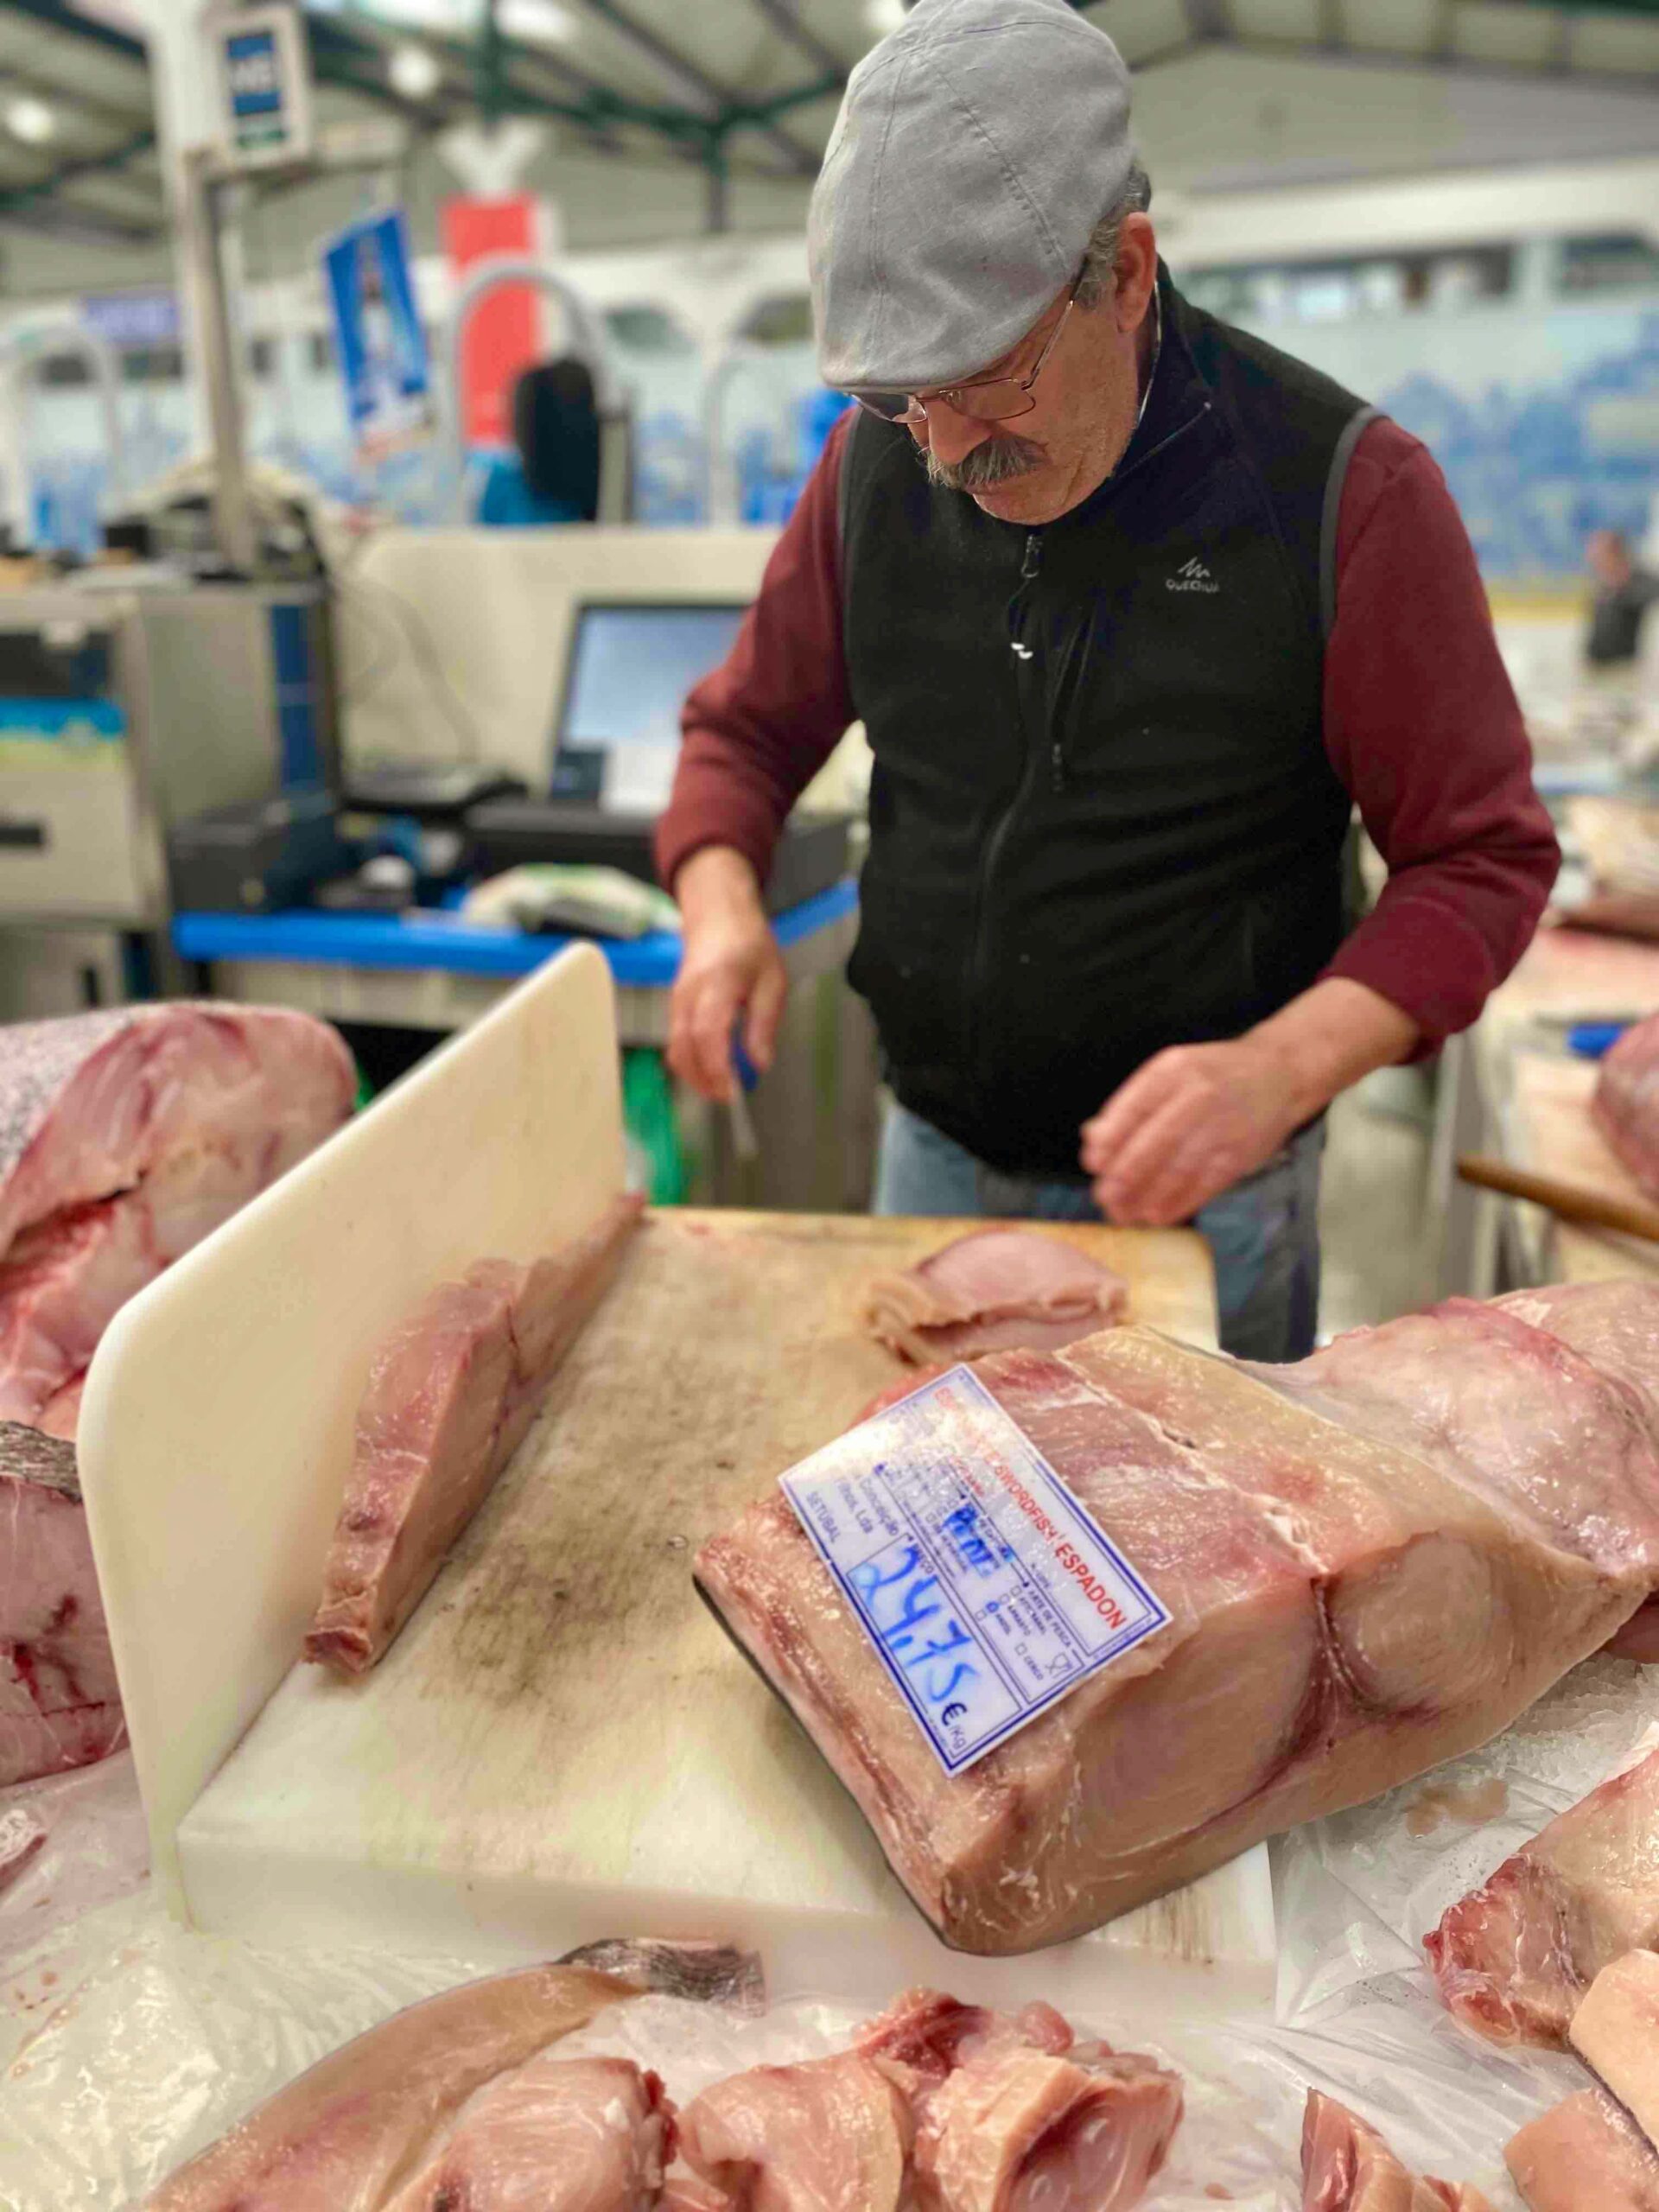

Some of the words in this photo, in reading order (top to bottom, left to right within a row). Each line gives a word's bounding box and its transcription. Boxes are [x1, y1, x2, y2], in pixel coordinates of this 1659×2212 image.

[855, 1510, 875, 1535] Lda
[1054, 1543, 1127, 1630] ESPADON
[1027, 1589, 1046, 1610] ARTE
[1041, 1609, 1053, 1621] DE
[1050, 1620, 1072, 1648] PESCA
